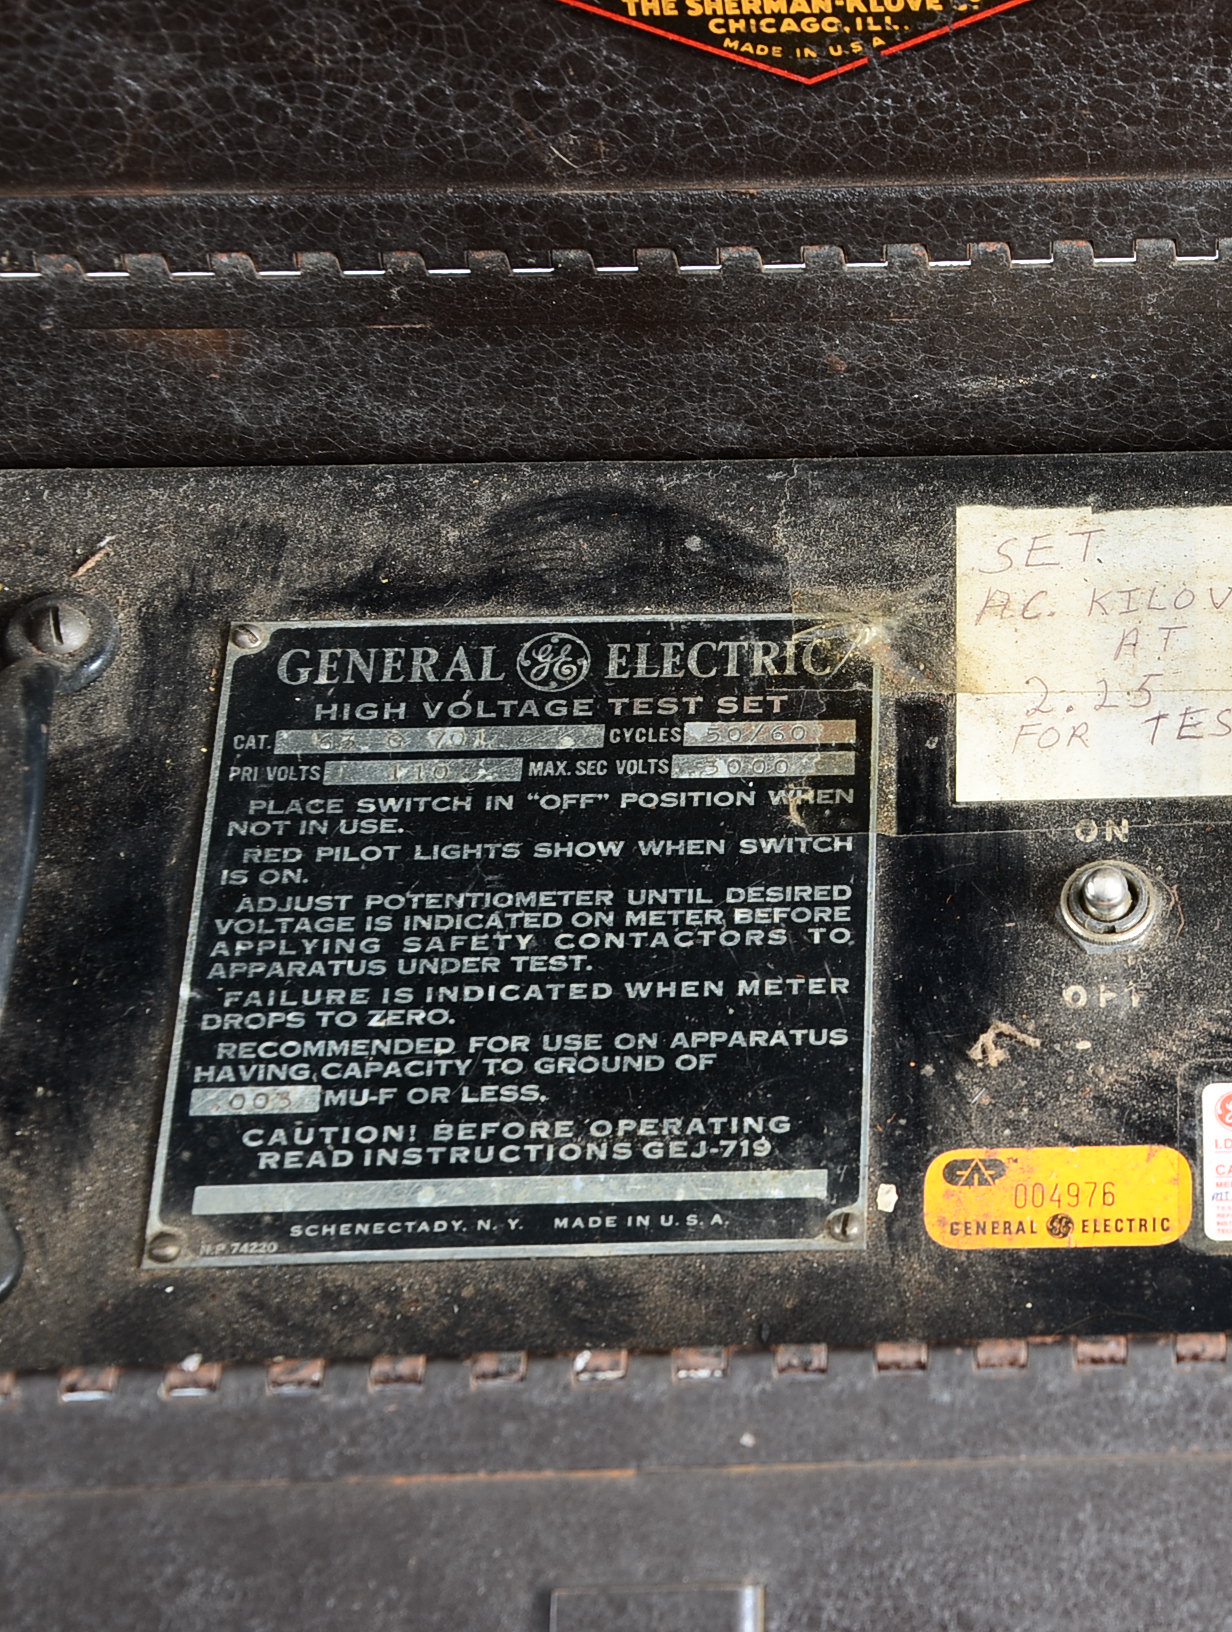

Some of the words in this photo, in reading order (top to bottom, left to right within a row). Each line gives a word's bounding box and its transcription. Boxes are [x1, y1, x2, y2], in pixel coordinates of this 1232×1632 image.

[622, 0, 678, 17] THE
[708, 15, 850, 34] CHICAGO,
[856, 14, 911, 32] ILL.
[723, 37, 783, 58] MADE
[796, 47, 818, 58] IN
[1113, 625, 1189, 662] AT
[276, 645, 505, 685] GENERAL
[604, 639, 832, 679] ELECTRIC
[315, 701, 406, 721] HIGH
[422, 698, 594, 719] VOLTAGE
[608, 696, 703, 717] TEST
[717, 694, 788, 715] SET
[1024, 672, 1164, 718] 2.25
[233, 734, 272, 751] CAT.
[609, 728, 682, 745] CYCLES
[706, 723, 807, 744] 50/60
[1012, 720, 1091, 755] FOR
[229, 765, 260, 783] PRI
[266, 764, 321, 782] VOLTS
[528, 760, 571, 777] MAX.
[575, 760, 608, 777] SEC
[616, 758, 670, 775] VOLTS
[249, 798, 344, 815] PLACE
[356, 796, 472, 814] SWITCH
[485, 794, 514, 812] IN
[620, 790, 756, 809] POSITION
[768, 788, 854, 806] WHEN
[227, 820, 291, 837] NOT
[300, 819, 329, 835] IN
[340, 817, 405, 835] USE.
[1074, 818, 1130, 843] ON
[243, 847, 303, 865] RED
[315, 845, 401, 863] PILOT
[414, 842, 522, 861] LIGHTS
[533, 840, 625, 859] SHOW
[637, 838, 727, 857] WHEN
[738, 836, 854, 855] SWITCH
[220, 869, 249, 886] IS
[258, 867, 310, 886] ON.
[235, 894, 354, 914] ADJUST
[365, 889, 614, 912] POTENTIOMETER
[627, 887, 714, 906] UNTIL
[726, 884, 853, 904] DESIRED
[214, 916, 355, 936] VOLTAGE
[365, 915, 393, 932] IS
[403, 911, 563, 932] INDICATED
[571, 911, 615, 928] ON
[625, 907, 724, 928] METER
[733, 905, 852, 925] BEFORE
[209, 936, 382, 957] APPLYING
[402, 933, 534, 953] SAFETY
[554, 928, 788, 951] CONTACTORS
[808, 926, 852, 945] TO
[206, 959, 387, 980] APPARATUS
[398, 956, 501, 976] UNDER
[511, 954, 593, 973] TEST.
[223, 987, 370, 1008] FAILURE
[382, 987, 414, 1003] IS
[425, 982, 613, 1002] INDICATED
[624, 979, 724, 999] WHEN
[736, 976, 850, 997] METER
[201, 1011, 306, 1031] DROPS
[315, 1010, 357, 1028] TO
[366, 1008, 456, 1028] ZERO.
[216, 1036, 456, 1060] RECOMMENDED
[468, 1035, 530, 1054] FOR
[541, 1032, 602, 1052] USE
[614, 1031, 658, 1050] ON
[670, 1028, 850, 1049] APPARATUS
[193, 1062, 311, 1083] HAVING
[320, 1058, 473, 1080] CAPACITY
[482, 1057, 524, 1076] TO
[533, 1054, 665, 1075] GROUND
[674, 1052, 718, 1072] OF
[323, 1086, 398, 1107] MU-F
[406, 1086, 452, 1105] OR
[460, 1084, 547, 1104] LESS.
[241, 1124, 417, 1148] CAUTION!
[432, 1119, 574, 1142] BEFORE
[589, 1115, 791, 1138] OPERATING
[257, 1150, 355, 1170] READ
[363, 1142, 632, 1167] INSTRUCTIONS
[641, 1138, 772, 1160] GEJ-719
[1014, 1180, 1116, 1209] 004976
[554, 1216, 617, 1230] MADE
[627, 1214, 651, 1228] IN
[949, 1219, 1038, 1236] GENERAL
[1081, 1216, 1171, 1234] ELECTRIC
[230, 1240, 279, 1255] 74220
